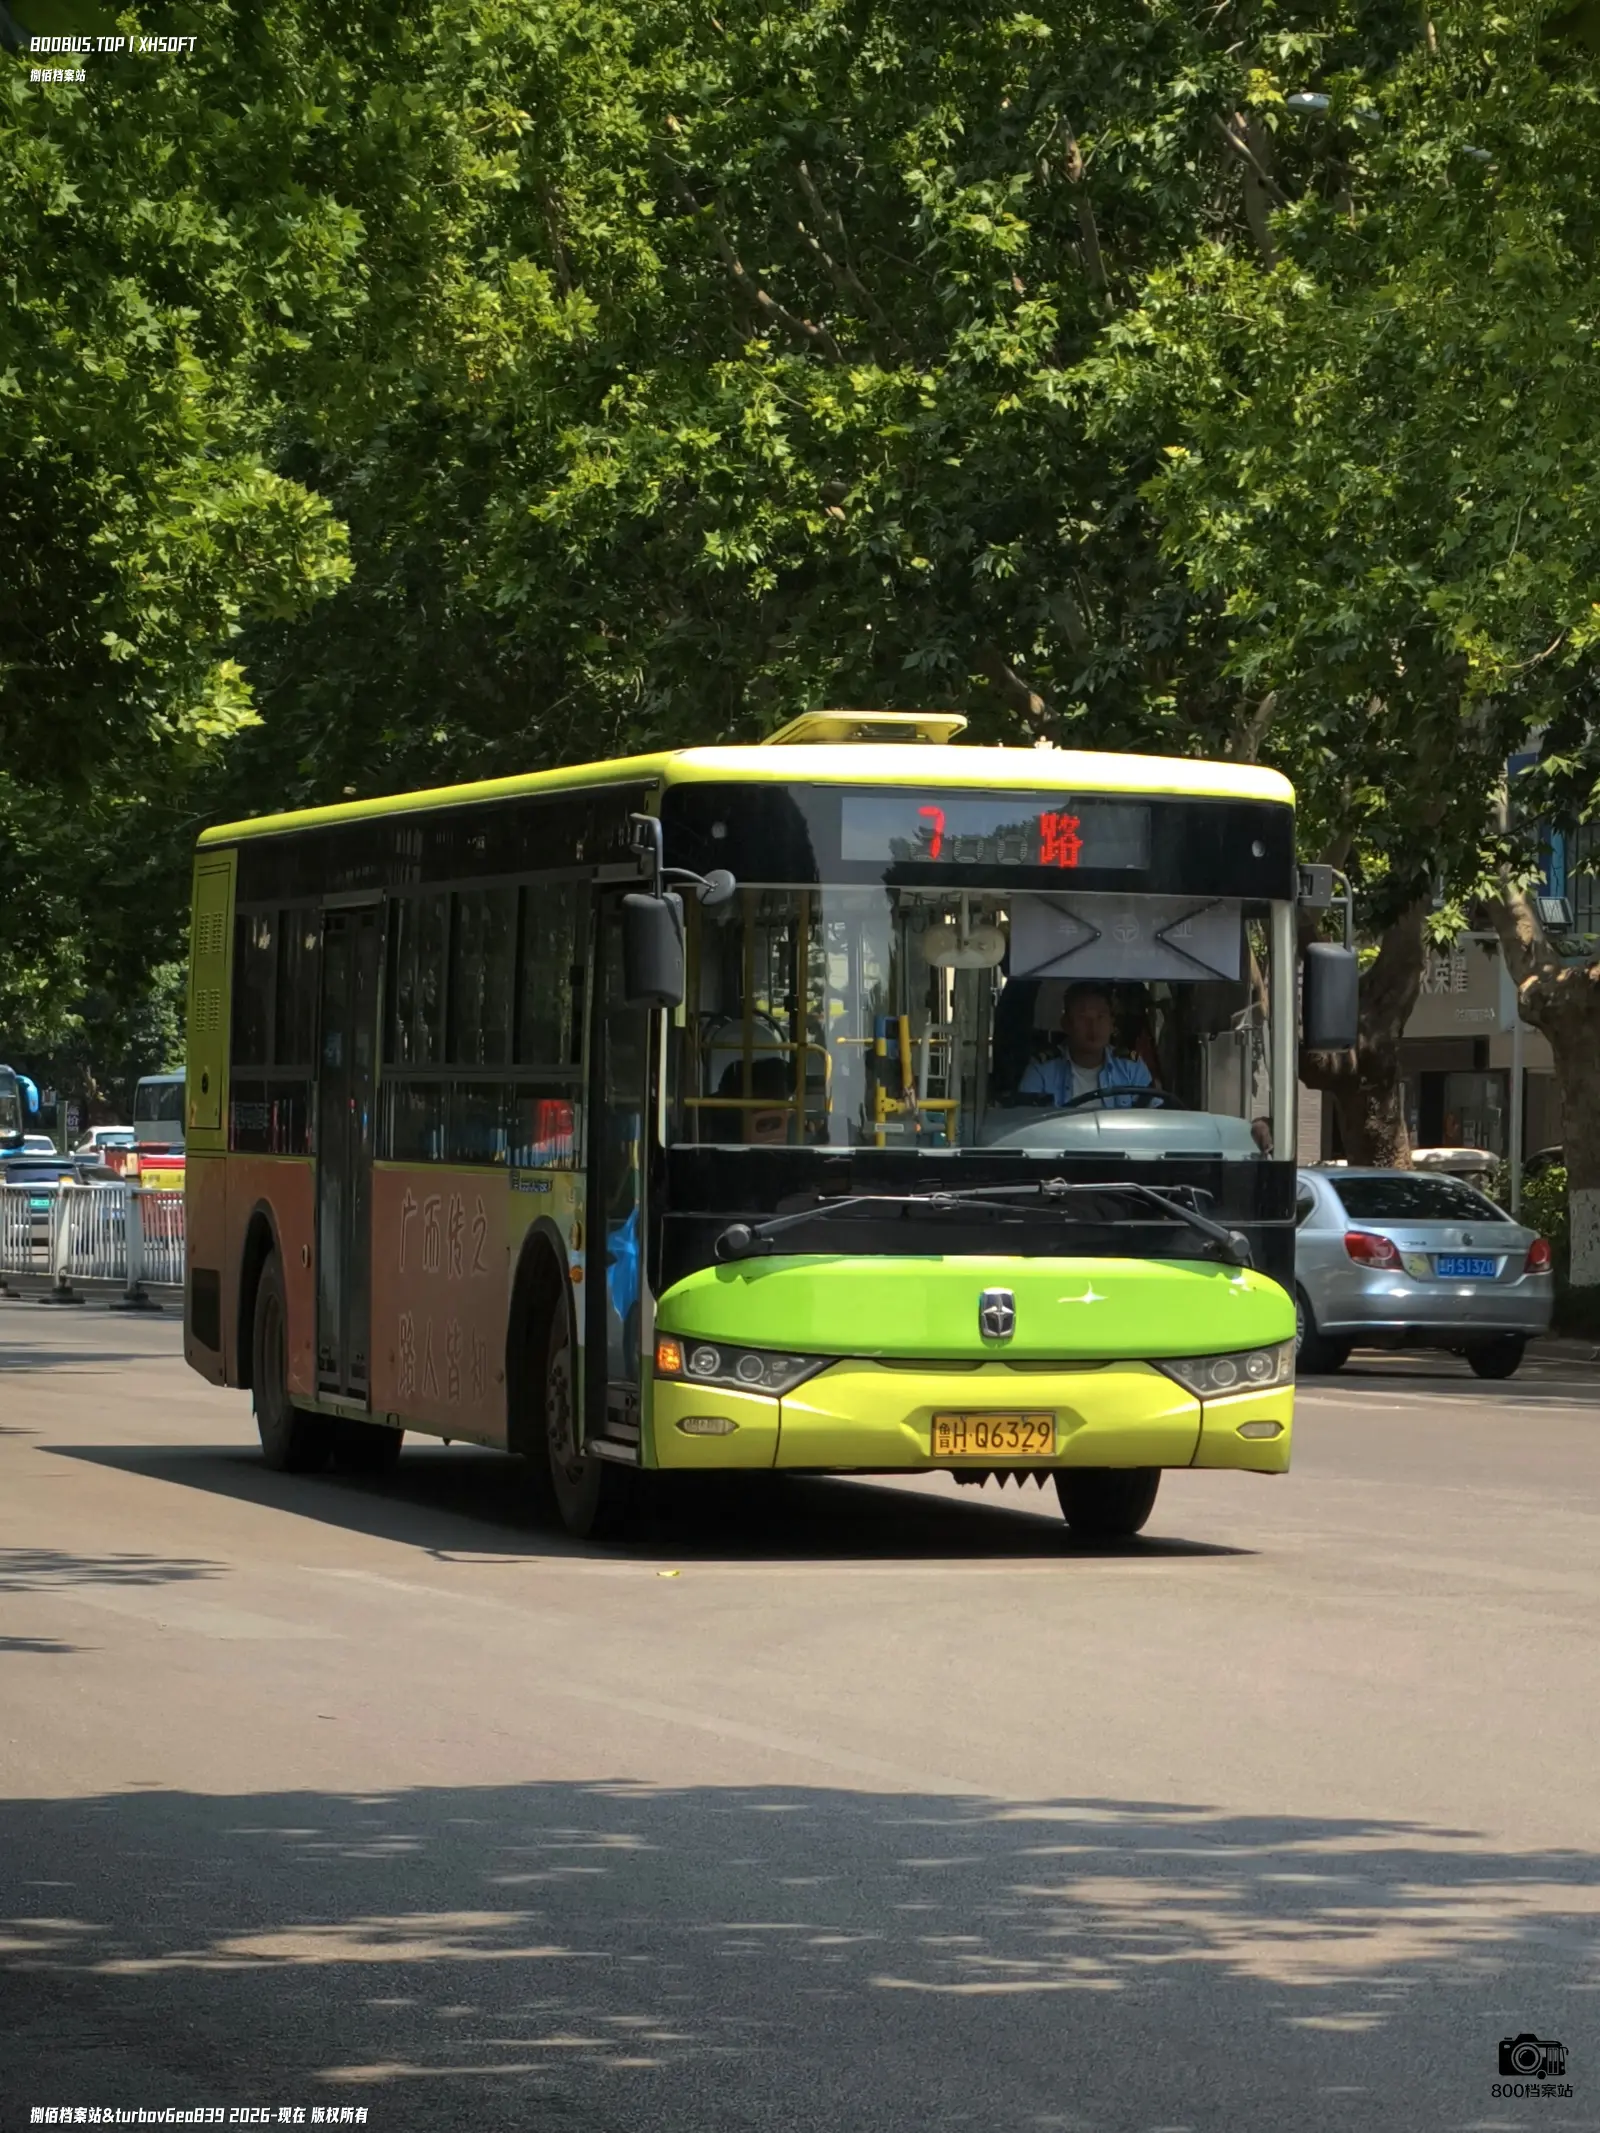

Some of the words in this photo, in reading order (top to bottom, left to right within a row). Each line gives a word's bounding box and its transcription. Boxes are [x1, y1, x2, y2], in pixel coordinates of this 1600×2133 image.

[1040, 811, 1083, 868] 路
[399, 1188, 489, 1280] 广而传之
[398, 1311, 488, 1406] 路人皆知
